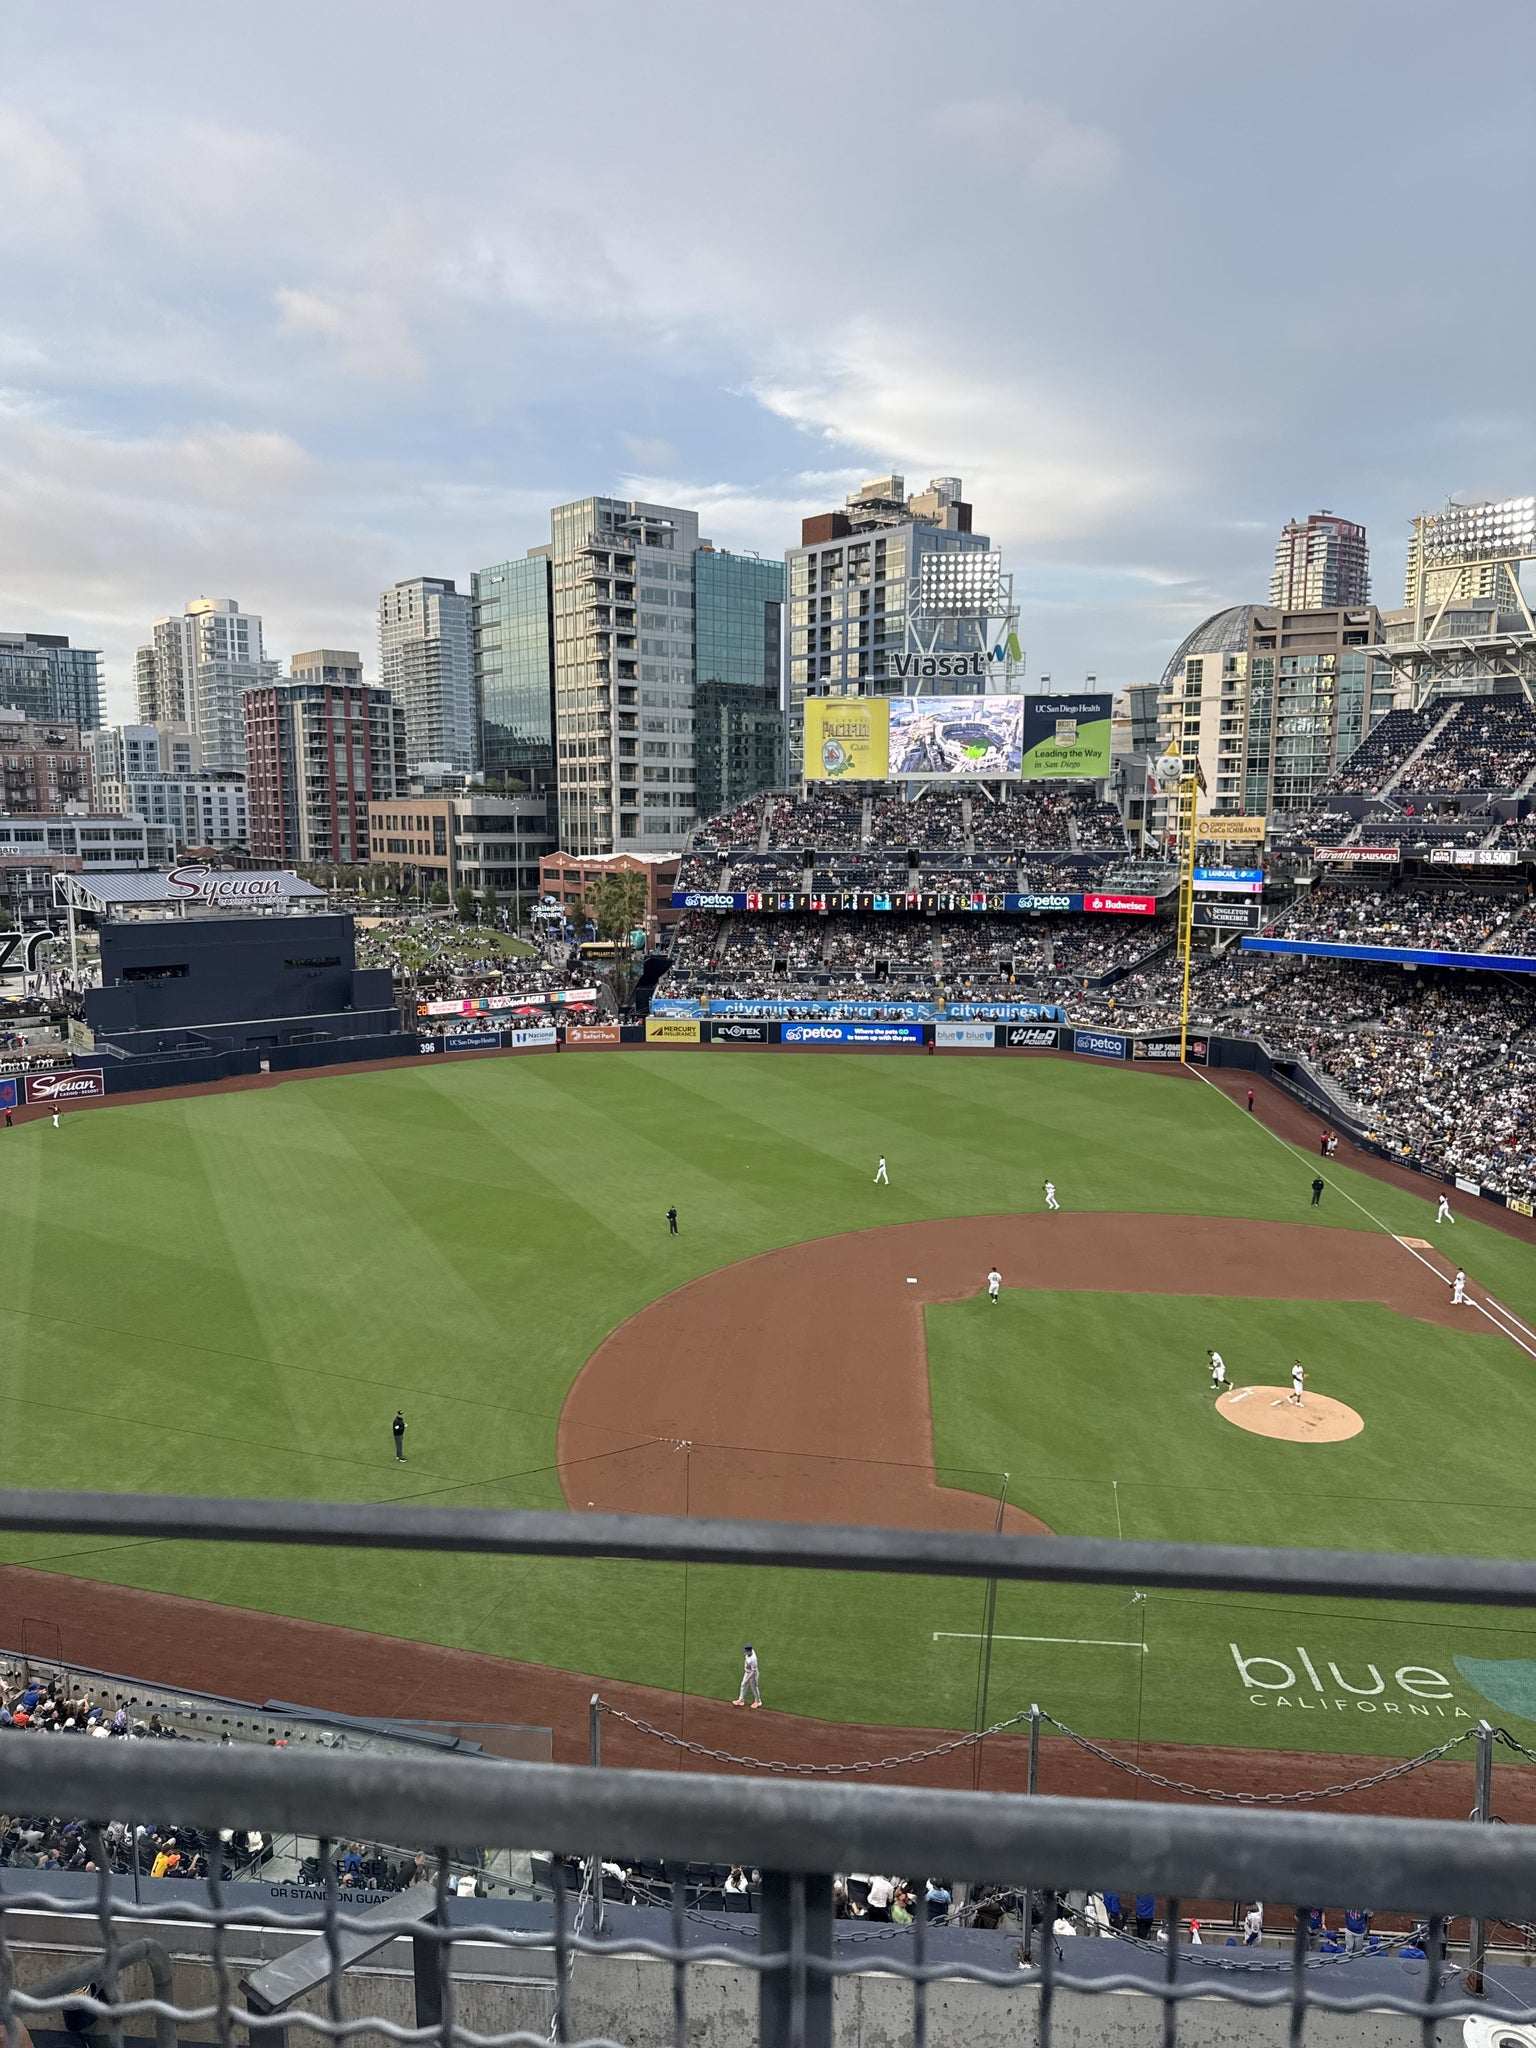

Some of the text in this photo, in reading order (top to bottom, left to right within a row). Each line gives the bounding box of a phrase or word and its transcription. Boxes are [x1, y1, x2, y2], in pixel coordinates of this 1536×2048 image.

[894, 652, 983, 677] Viasat
[1035, 704, 1101, 714] UC San Diego Health
[1035, 749, 1102, 759] Leading the Way
[1044, 761, 1058, 769] San
[1060, 760, 1081, 769] Diego
[1226, 826, 1262, 834] ICHIBANYA
[1316, 848, 1397, 861] Tarantino SAUSAGES
[1479, 852, 1511, 864] $9,500
[166, 865, 285, 907] Sycuan
[700, 894, 734, 907] petco
[1034, 895, 1070, 908] petco
[1105, 900, 1147, 911] Budweiser
[1212, 907, 1248, 916] SINGLETON
[1212, 912, 1248, 922] SCHREIBER
[521, 995, 546, 1004] LAGER
[416, 1005, 427, 1016] 28
[951, 1004, 1038, 1018] citycruises
[803, 1026, 843, 1040] petco
[937, 1030, 956, 1039] blue
[966, 1030, 984, 1039] blue
[457, 1038, 468, 1046] San
[468, 1038, 481, 1046] Diego
[1090, 1038, 1122, 1051] petco
[420, 1043, 435, 1054] 396
[32, 1076, 96, 1098] Sycuan
[1229, 1643, 1454, 1699] blue
[1250, 1695, 1472, 1719] CALIFORNIA
[315, 1858, 382, 1876] PEASE
[297, 1876, 314, 1886] DO
[270, 1888, 288, 1898] OR
[290, 1890, 328, 1900] STAND
